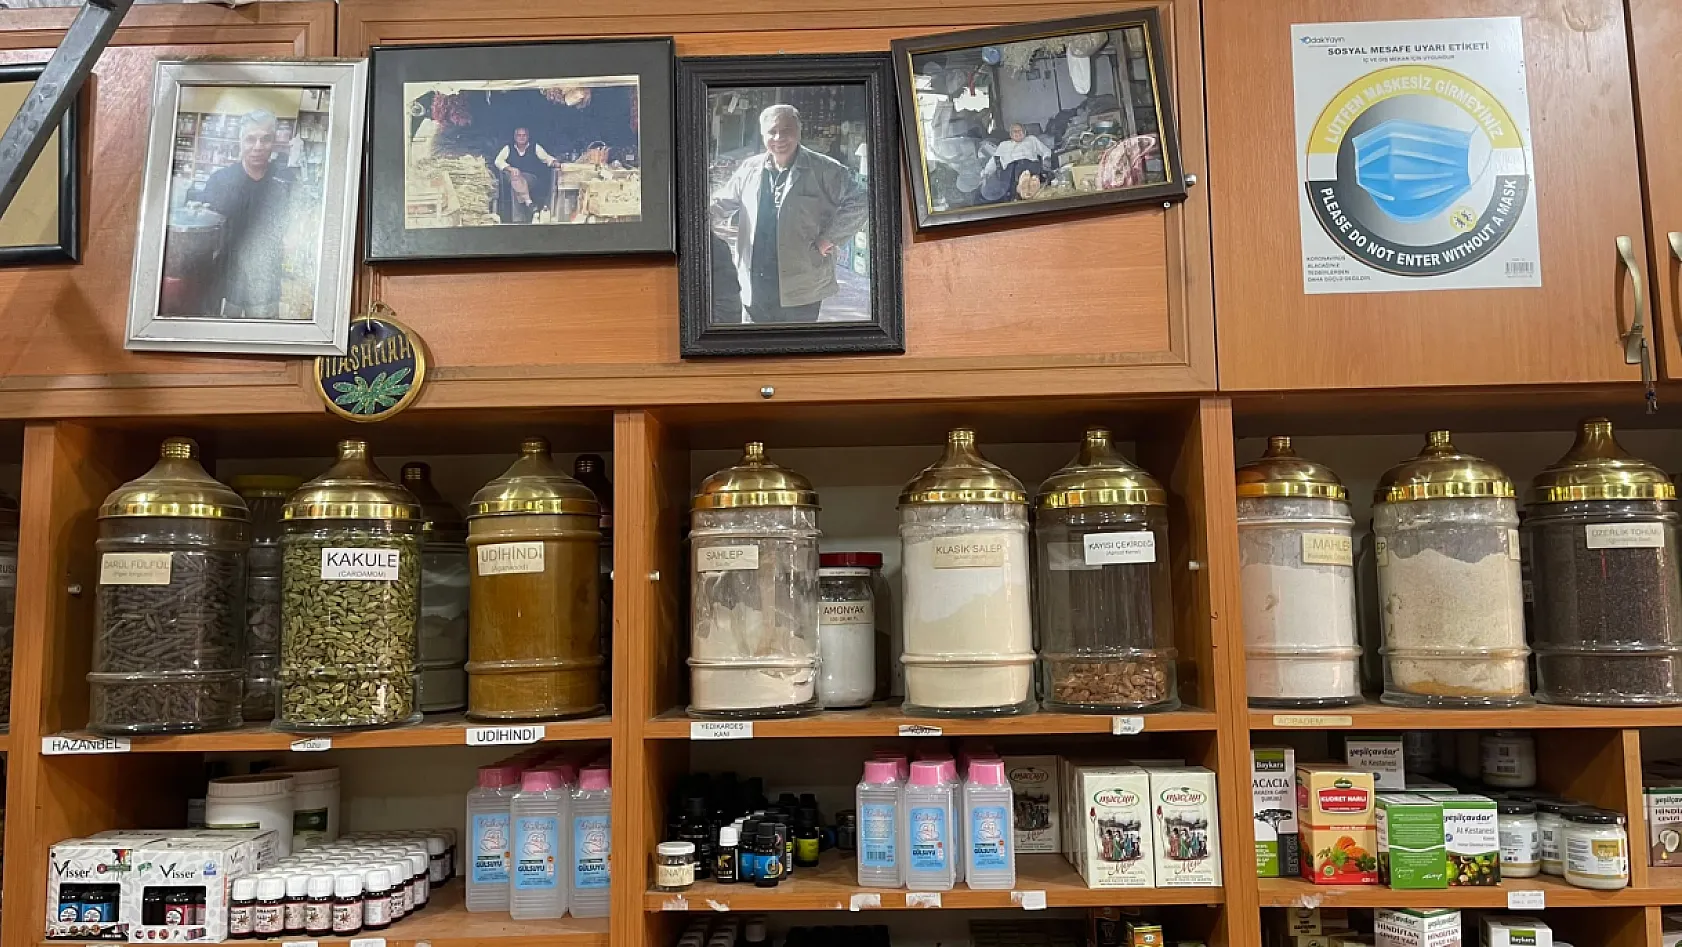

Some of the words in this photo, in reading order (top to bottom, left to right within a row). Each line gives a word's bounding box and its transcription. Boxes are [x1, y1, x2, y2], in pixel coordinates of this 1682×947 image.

[1327, 47, 1367, 56] SOSYAL
[1370, 45, 1411, 55] MESAFE
[1415, 43, 1446, 53] UYARI
[1448, 41, 1490, 51] ETİKETİ
[1324, 94, 1366, 145] LÜTFEN
[1363, 74, 1434, 103] MASKESİZ
[1434, 76, 1505, 141] GİRMEYİNİZ
[1320, 187, 1354, 235] PLEASE
[1348, 229, 1369, 249] DO
[1366, 241, 1396, 263] NOT
[1396, 252, 1442, 267] ENTER
[1442, 226, 1496, 264] WITHOUT
[1494, 214, 1503, 226] A
[1499, 179, 1518, 218] MASK
[705, 550, 744, 561] SAHLEP
[936, 544, 971, 555] KLASİK
[973, 544, 1002, 553] SALEP
[327, 552, 398, 568] KAKULE
[823, 605, 865, 615] AMONYAK
[52, 737, 122, 752] HAZANBEL
[1256, 761, 1284, 770] Baykara
[1252, 779, 1290, 788] ACACIA
[1320, 795, 1347, 803] KUDRET
[54, 859, 92, 879] Visser
[159, 862, 197, 879] Visser
[1511, 935, 1535, 944] Baykara
